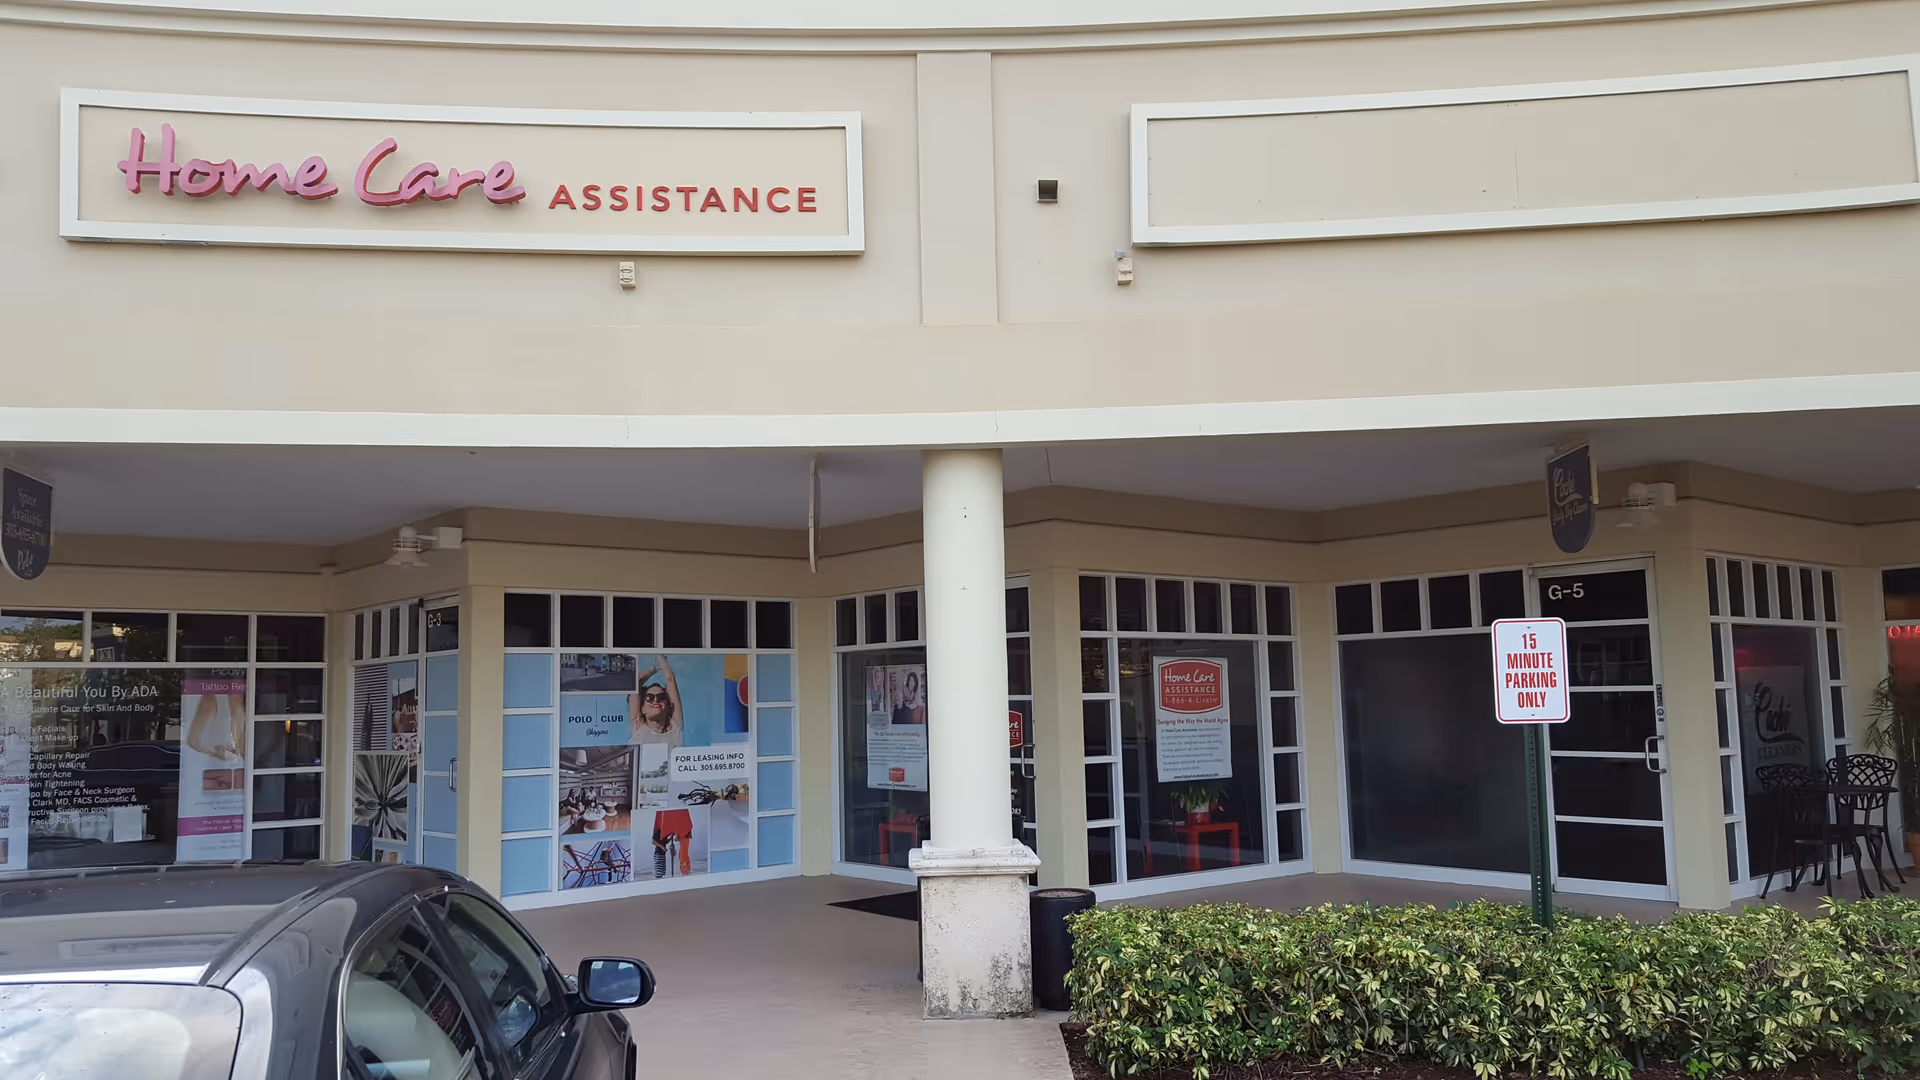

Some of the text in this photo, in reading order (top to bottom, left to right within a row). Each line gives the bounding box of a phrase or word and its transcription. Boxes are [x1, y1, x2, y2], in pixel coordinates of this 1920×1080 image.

[118, 123, 818, 214] Home Care ASSISTANCE
[1548, 583, 1584, 600] G-5
[428, 613, 442, 628] G-3
[1522, 633, 1537, 650] 15
[1507, 652, 1554, 669] MINUTE
[1164, 668, 1215, 683] Home Care
[1505, 671, 1557, 689] PARKING
[200, 682, 229, 691] Tattoo
[1165, 686, 1216, 694] ASSISTANCE
[15, 686, 78, 699] Beautiful
[82, 686, 107, 698] You
[112, 686, 127, 700] By
[131, 685, 158, 697] ADA
[1517, 691, 1547, 709] ONLY
[61, 705, 80, 713] Care
[83, 704, 94, 712] for
[96, 704, 115, 712] Skin
[116, 704, 132, 712] And
[134, 703, 155, 713] Body
[568, 714, 624, 724] POLO CLUB
[44, 734, 79, 743] Make-up
[29, 752, 63, 762] Capillary
[65, 751, 91, 760] Repair
[675, 752, 745, 763] FOR LEASING INFO
[37, 761, 57, 770] Body
[700, 763, 745, 771] 305.695.8700
[44, 780, 85, 789] Tightening
[43, 790, 52, 798] by
[54, 788, 72, 796] Face
[83, 787, 102, 795] Neck
[104, 786, 136, 796] Surgeon
[73, 797, 92, 805] FACS
[95, 795, 129, 804] Cosmetic
